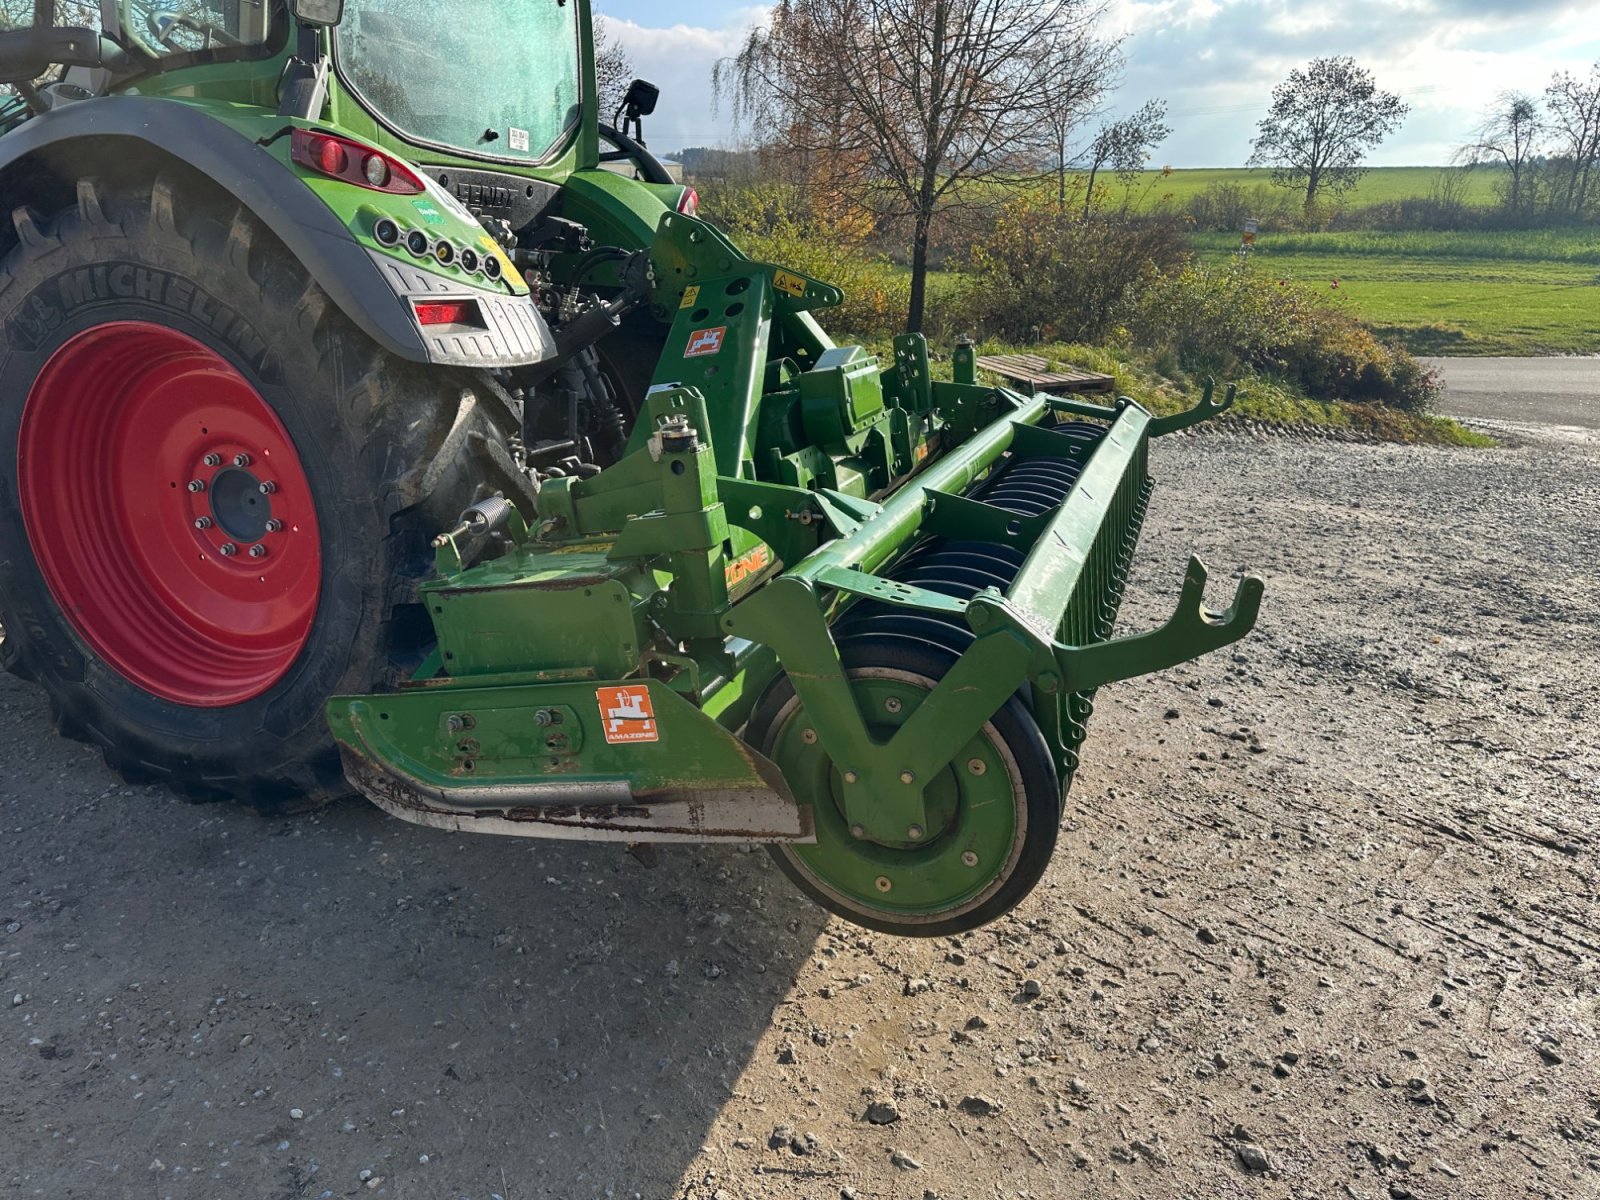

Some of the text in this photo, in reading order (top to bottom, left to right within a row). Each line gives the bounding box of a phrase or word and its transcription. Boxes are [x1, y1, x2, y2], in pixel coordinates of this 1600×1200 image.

[457, 183, 519, 208] FENDT
[58, 264, 267, 358] MICHELIN
[608, 732, 656, 740] AMAZONE
